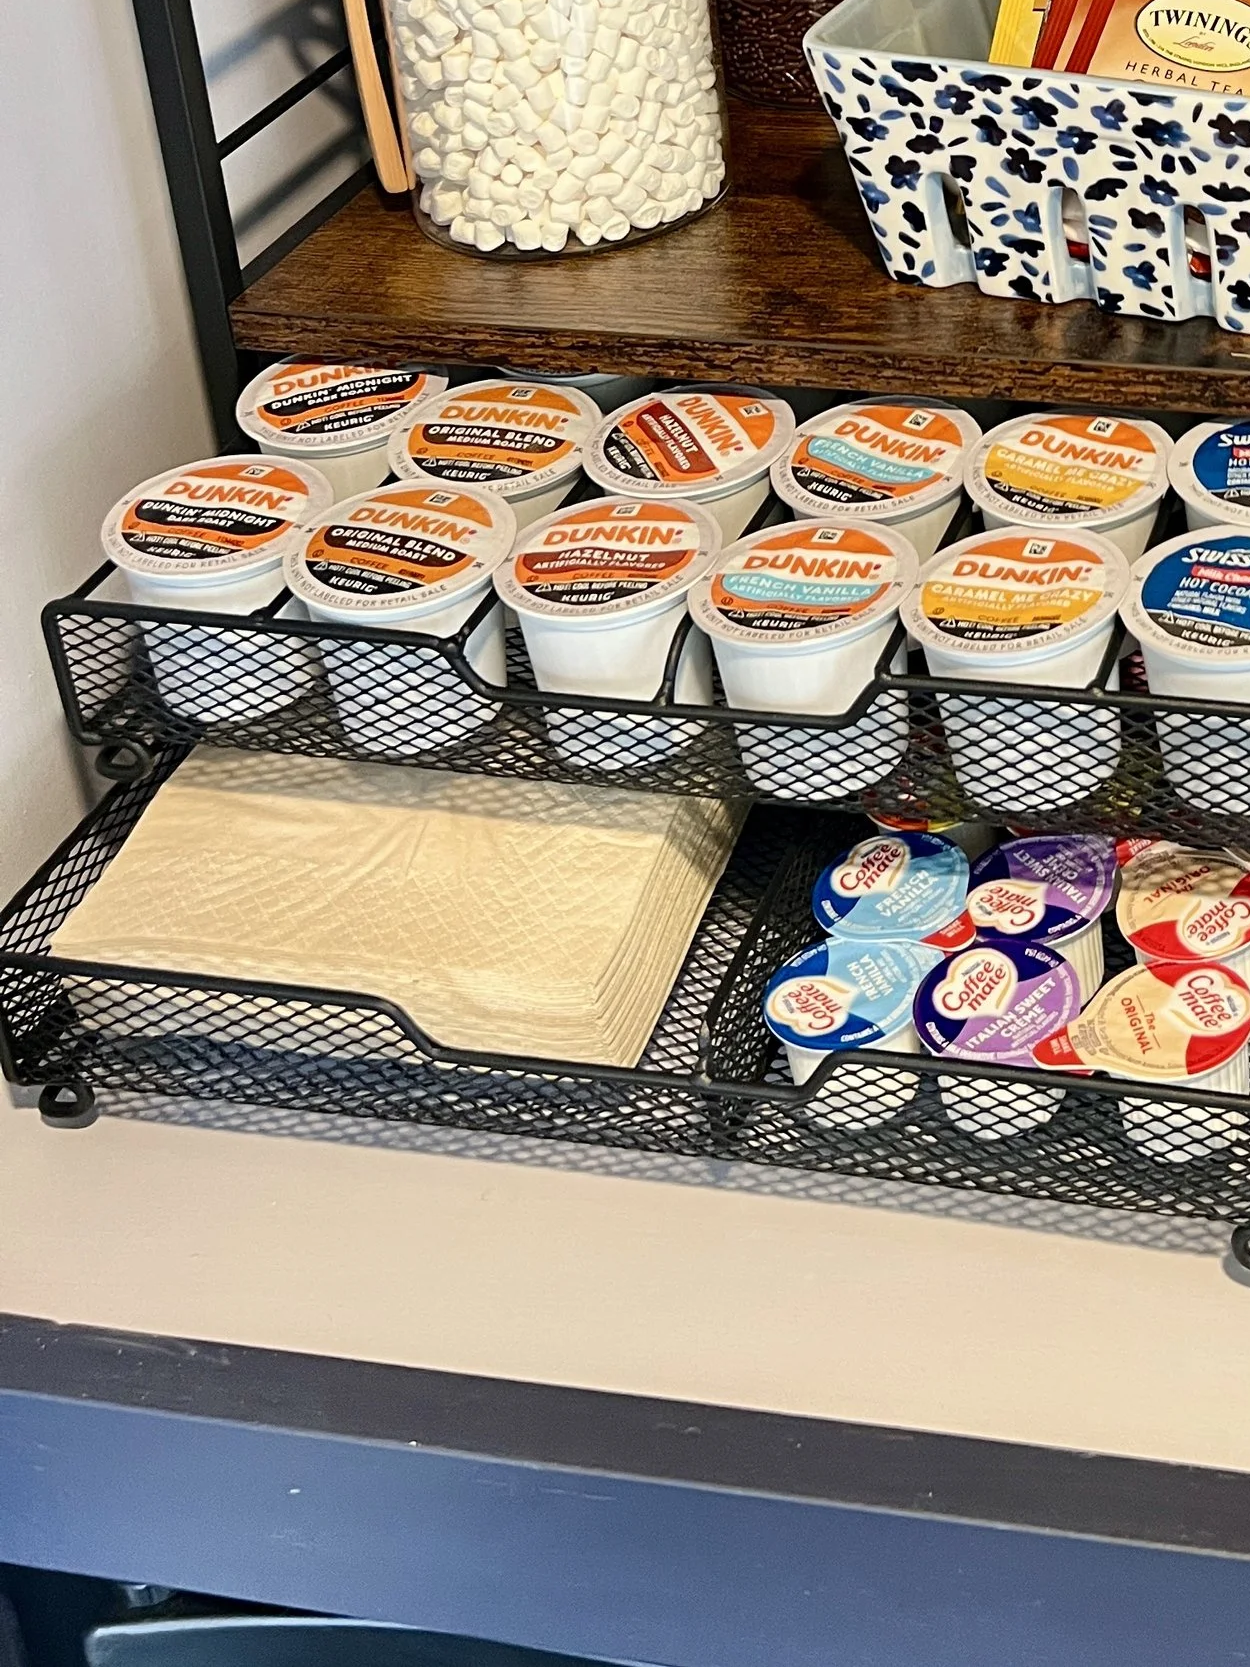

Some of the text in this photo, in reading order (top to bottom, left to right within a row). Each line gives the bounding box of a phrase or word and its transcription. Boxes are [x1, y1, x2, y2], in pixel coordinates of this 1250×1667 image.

[1125, 60, 1198, 86] HERBAL
[271, 374, 412, 410] DUNKIN' MIDNIGHT
[308, 394, 338, 406] DARK
[324, 415, 373, 431] KEURIG
[439, 406, 568, 430] DUNKIN'
[658, 413, 698, 453] HAZELNUT
[676, 396, 743, 452] DUNKIN'
[429, 426, 556, 447] ORIGINAL BLEND
[446, 436, 530, 449] MEDIUM ROAST
[834, 420, 945, 463] DUNKIN'
[1020, 431, 1143, 470] DUNKIN'
[815, 439, 924, 478] FRENCH VANILLA
[996, 449, 1060, 474] CARAMEL
[1088, 469, 1138, 487] CRAZY
[441, 469, 489, 480] KEURIG
[164, 481, 294, 510] DUNKIN'
[807, 482, 851, 501] KEURIG
[142, 501, 276, 528] DUNKIN' MIDNIGHT
[349, 507, 477, 541] DUNKIN'
[331, 528, 456, 561] ORIGINAL BLEND
[345, 539, 428, 562] MEDIUM ROAST
[543, 525, 684, 546] DUNKIN'
[350, 556, 389, 570] COFFEE
[558, 550, 649, 562] HAZELNUT
[743, 554, 881, 579] DUNKIN'
[329, 576, 374, 593] KEURIG
[729, 575, 872, 595] FRENCH VANILLA
[952, 561, 1092, 585] DUNKIN'
[1179, 577, 1206, 589] HOT
[561, 591, 612, 602] KEURIG
[931, 584, 1094, 603] CARAMEL ME CRAZY
[752, 619, 800, 628] KEURIG
[1181, 630, 1231, 646] KEURIG
[840, 843, 891, 891] Coffee
[863, 847, 901, 889] mate
[1013, 850, 1050, 877] SWEET
[875, 869, 929, 911] FRENCH
[880, 876, 940, 917] VANILLA
[989, 886, 1037, 906] mate
[1045, 873, 1088, 904] ITALIAN
[1143, 865, 1211, 904] ORIGINAL
[980, 894, 1036, 926] Coffee
[1187, 901, 1228, 936] mate
[1199, 901, 1250, 942] Coffee
[847, 961, 882, 1002] FRENCH
[859, 954, 894, 996] VANILLA
[942, 960, 995, 1012] Coffee
[968, 968, 1007, 1012] mate
[789, 990, 835, 1030] Coffee
[801, 984, 843, 1012] mate
[965, 1011, 1016, 1049] ITALIAN
[1014, 977, 1057, 1014] SWEET
[1178, 990, 1219, 1029] mate
[1188, 975, 1233, 1022] Coffee
[1121, 997, 1153, 1055] ORIGINAL
[1143, 1012, 1156, 1030] The
